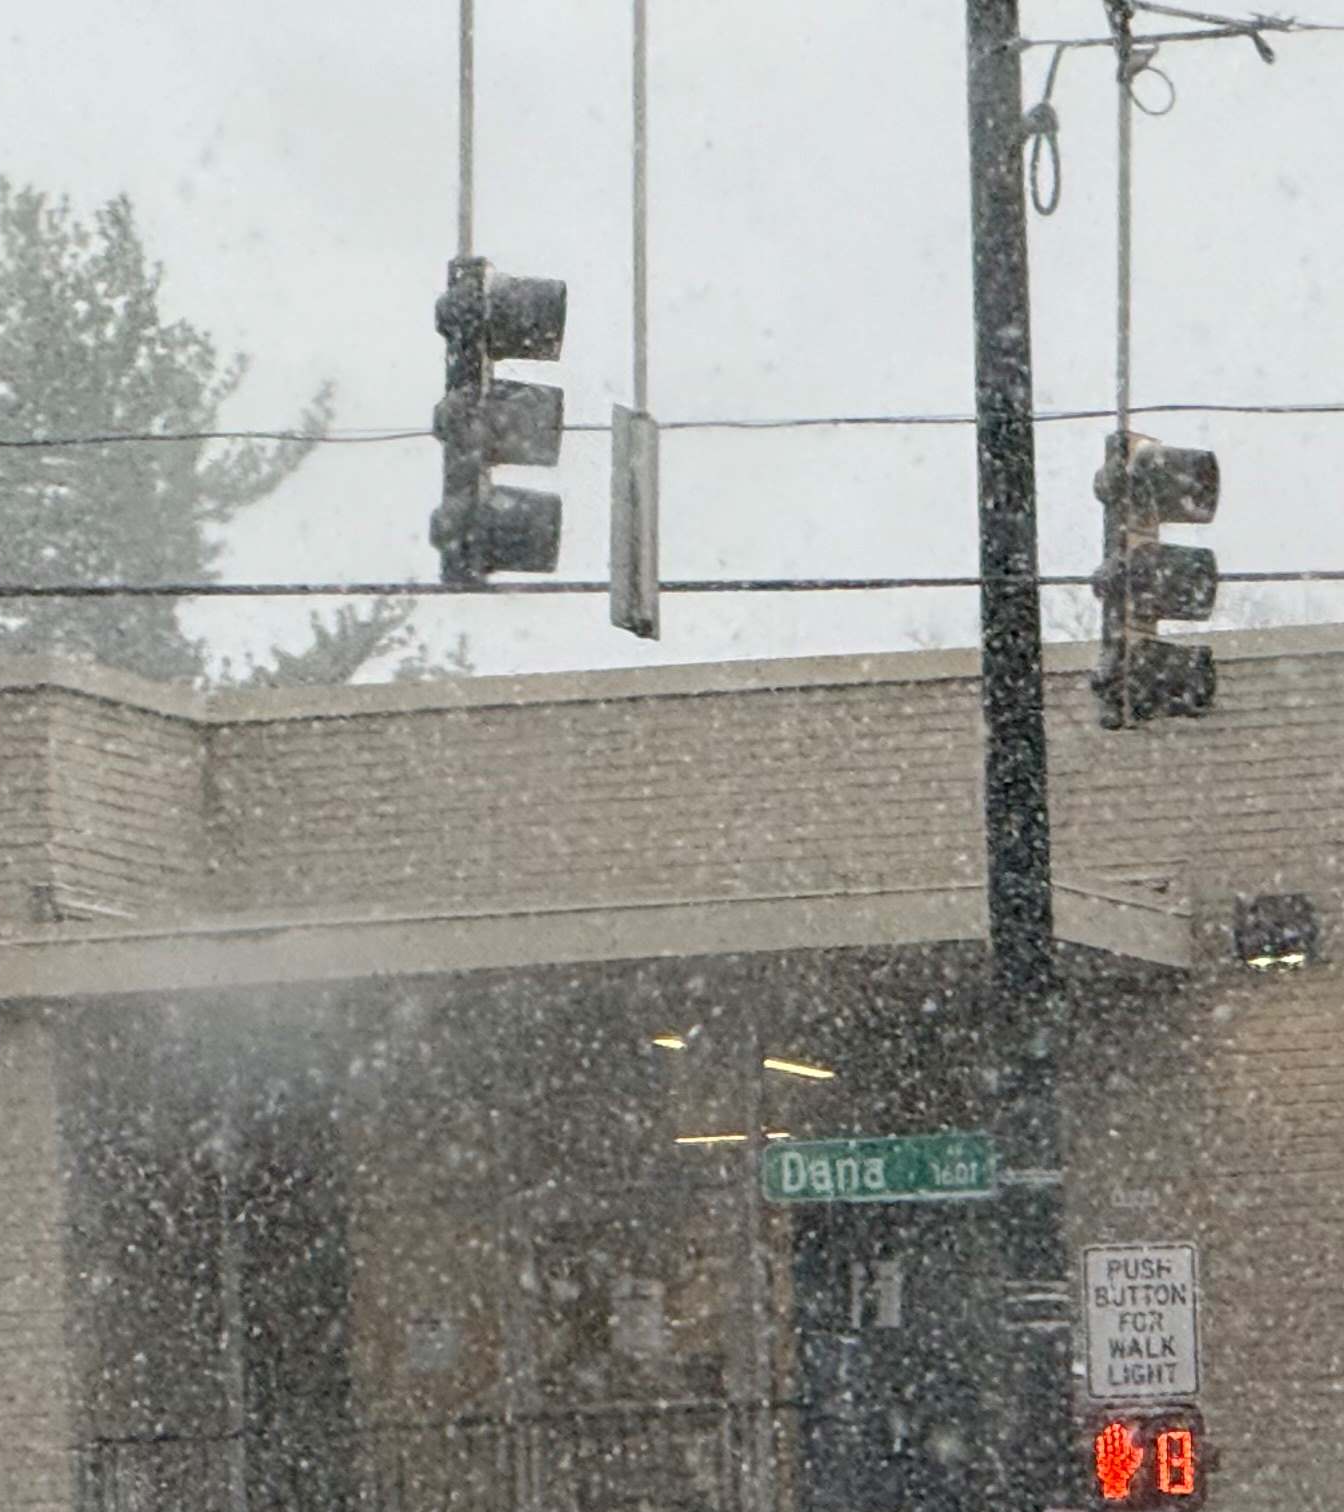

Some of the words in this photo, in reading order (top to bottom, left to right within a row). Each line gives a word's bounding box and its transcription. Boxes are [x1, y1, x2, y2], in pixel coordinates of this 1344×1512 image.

[781, 1150, 885, 1193] Dana
[1107, 1258, 1172, 1280] PUSH
[1094, 1283, 1187, 1308] BUTTON
[1118, 1311, 1164, 1333] FOR
[1109, 1336, 1176, 1359] WALK
[1108, 1362, 1177, 1386] LIGHT
